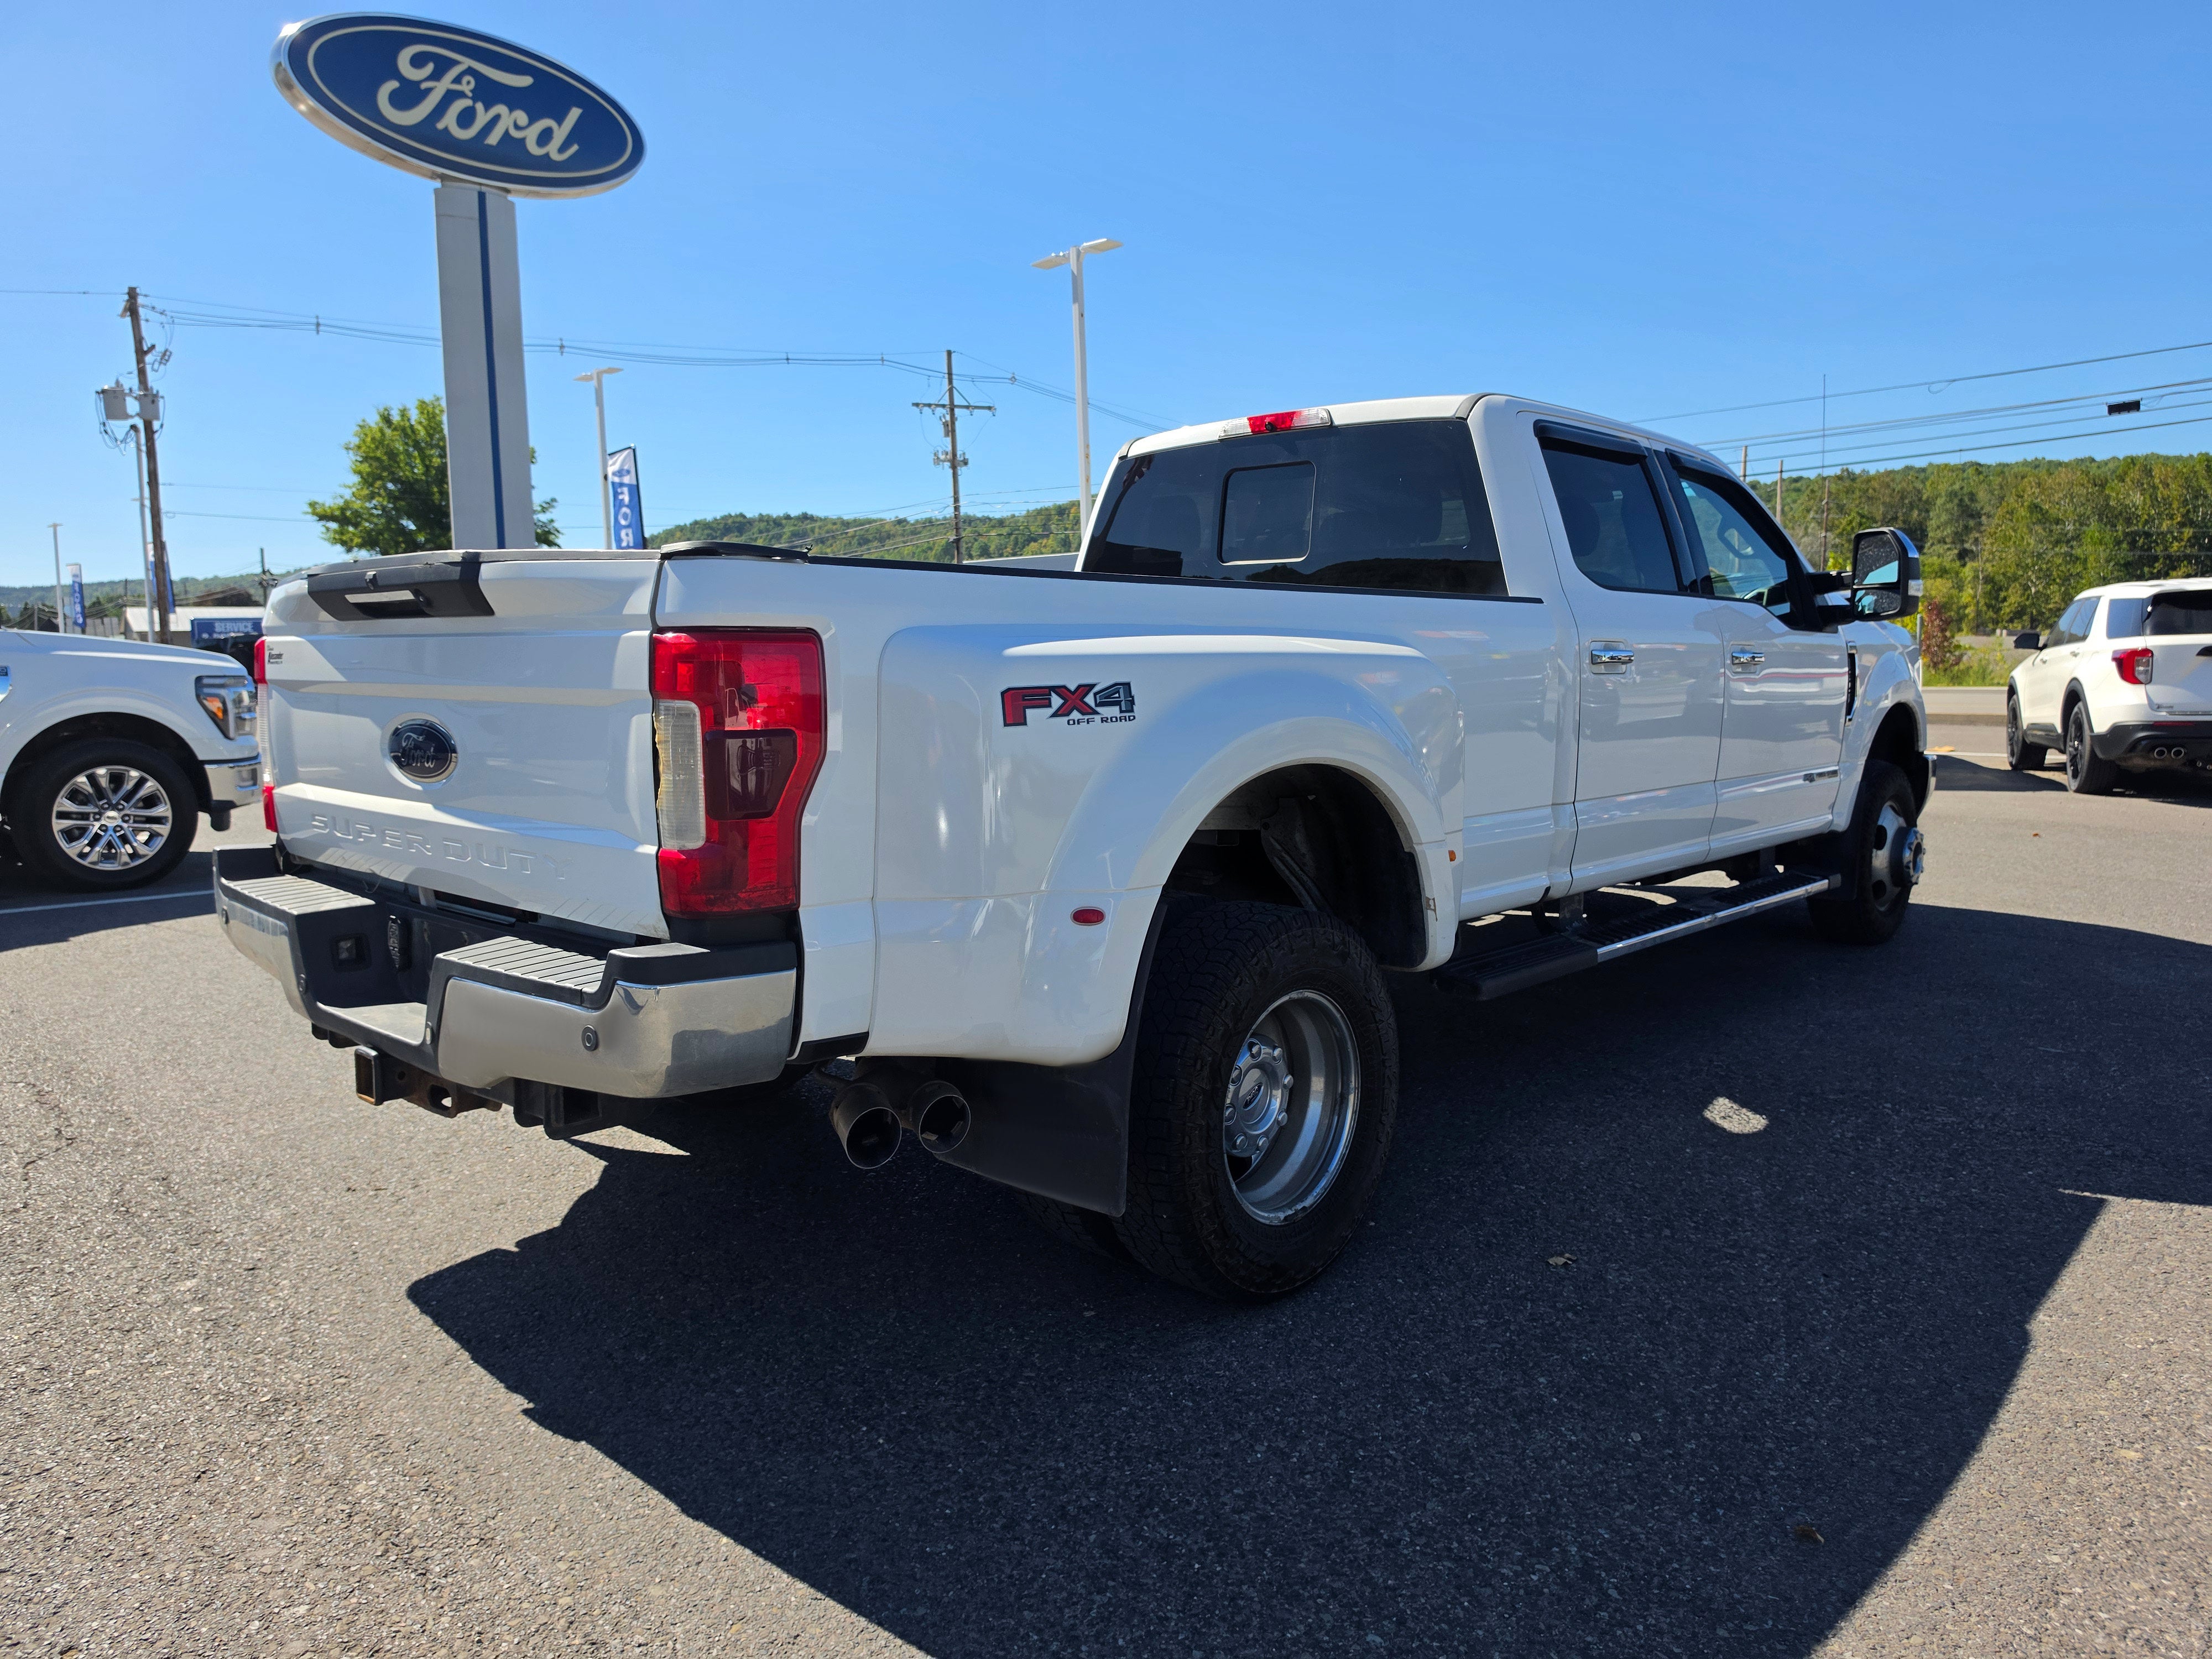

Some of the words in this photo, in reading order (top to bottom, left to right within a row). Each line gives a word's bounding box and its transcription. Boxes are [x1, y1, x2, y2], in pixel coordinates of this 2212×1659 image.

[377, 44, 582, 161] Ford
[215, 622, 254, 633] SERVICE
[1000, 681, 1135, 728] FX4
[1067, 717, 1095, 726] OFF
[1100, 715, 1136, 724] ROAD
[400, 732, 436, 768] Ford
[311, 815, 432, 856] SUPER
[442, 837, 574, 880] DUTY
